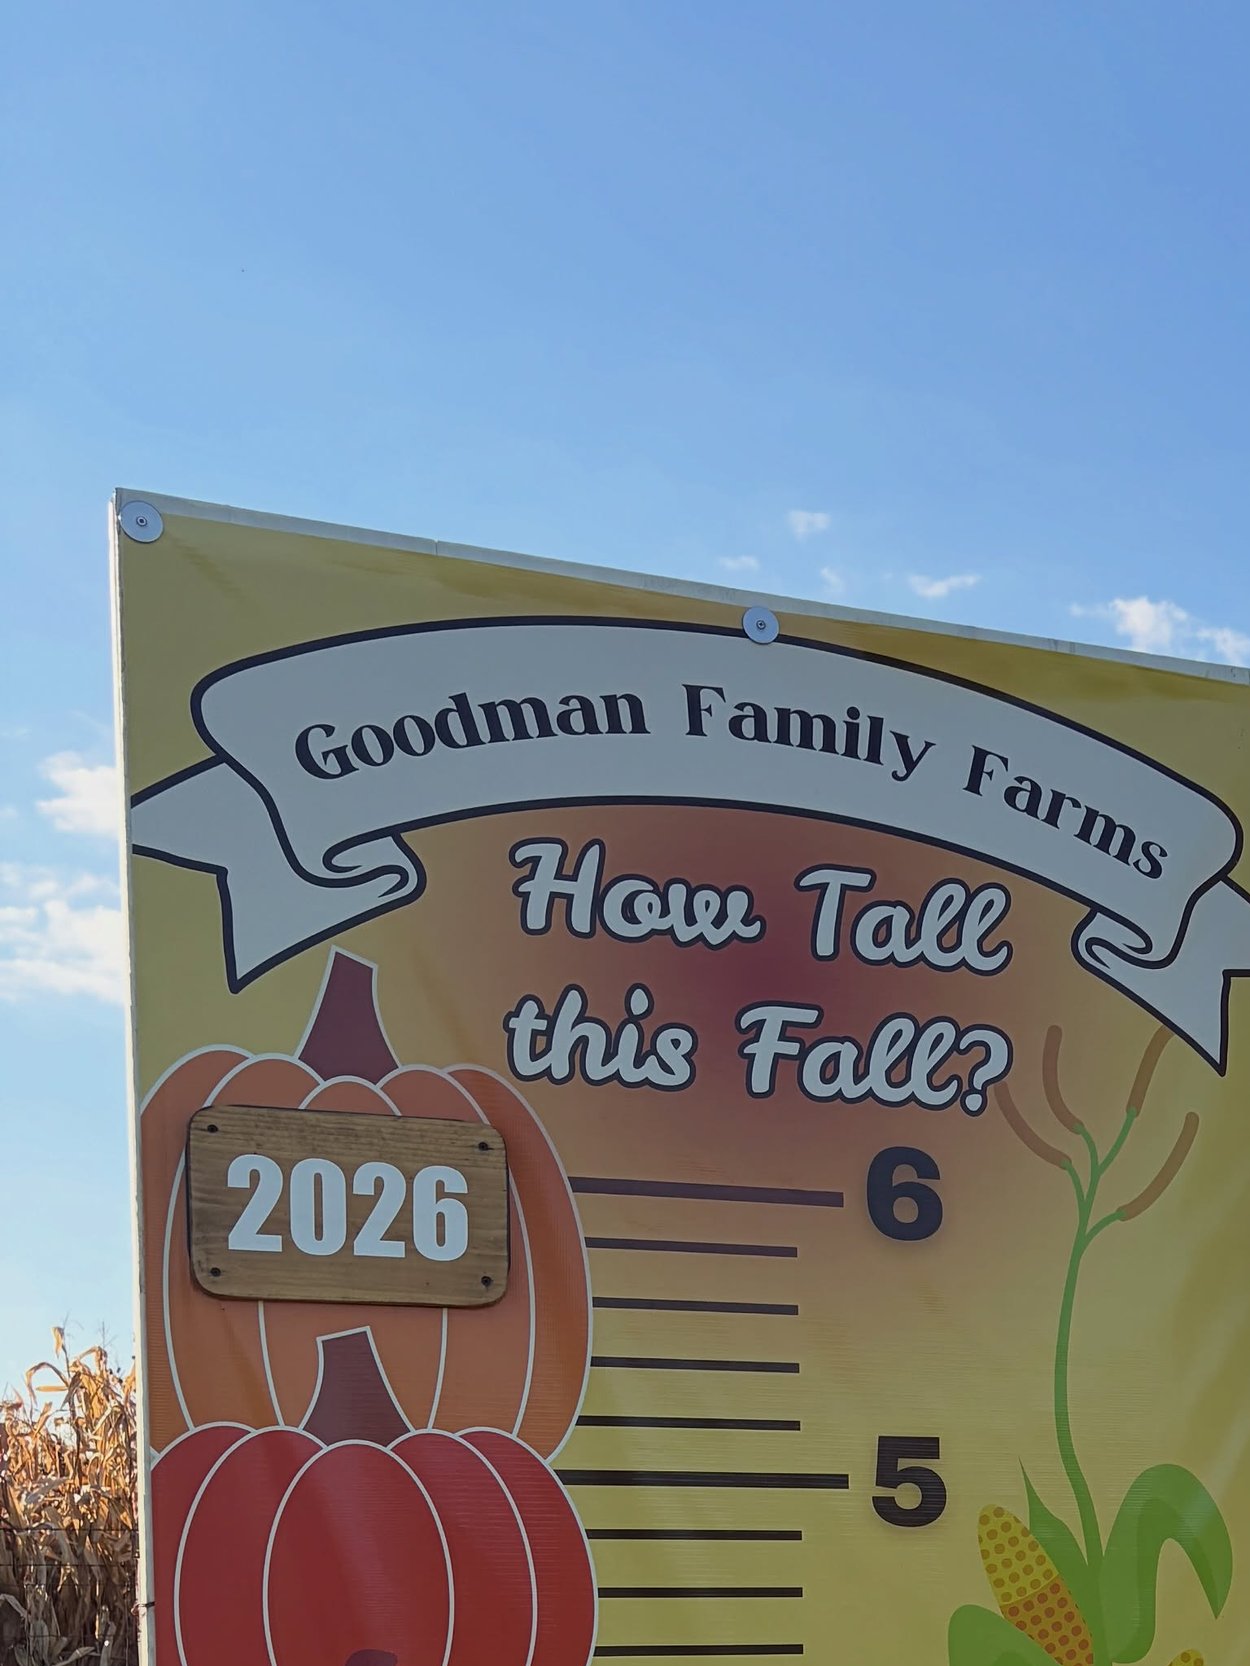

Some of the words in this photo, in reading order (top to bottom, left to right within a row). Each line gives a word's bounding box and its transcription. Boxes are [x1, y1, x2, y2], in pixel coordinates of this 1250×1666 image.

[295, 692, 651, 779] Goodman
[682, 684, 937, 781] Family
[962, 745, 1168, 879] Farms
[509, 837, 766, 950] How
[794, 864, 1013, 975] Tall
[503, 983, 697, 1088] this
[735, 1001, 1013, 1116] Fall?
[227, 1154, 469, 1262] 2026
[866, 1146, 943, 1241] 6
[872, 1436, 947, 1528] 5
